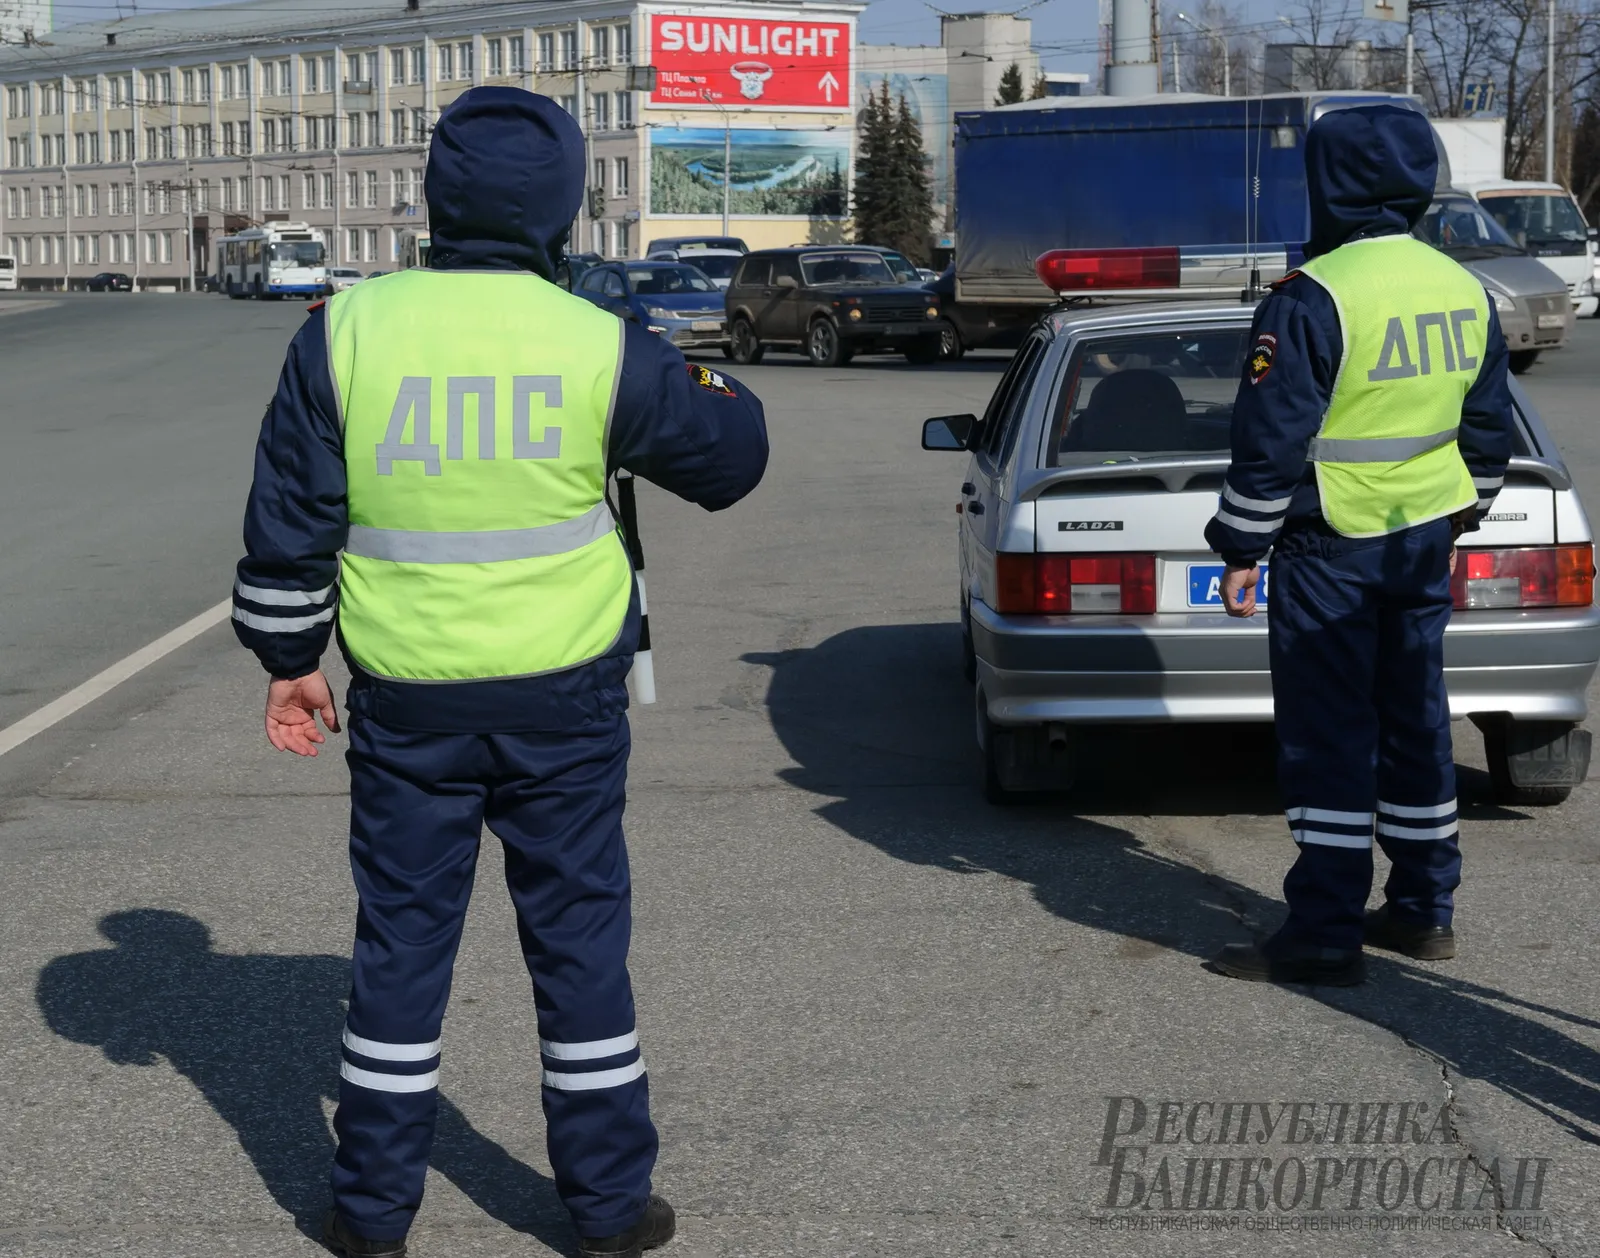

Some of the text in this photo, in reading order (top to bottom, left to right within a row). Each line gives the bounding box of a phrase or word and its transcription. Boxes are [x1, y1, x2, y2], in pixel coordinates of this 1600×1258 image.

[660, 21, 840, 57] SUNLIGHT
[1367, 308, 1478, 382] ДПС
[375, 375, 563, 476] ДПС
[1065, 522, 1116, 530] LADA
